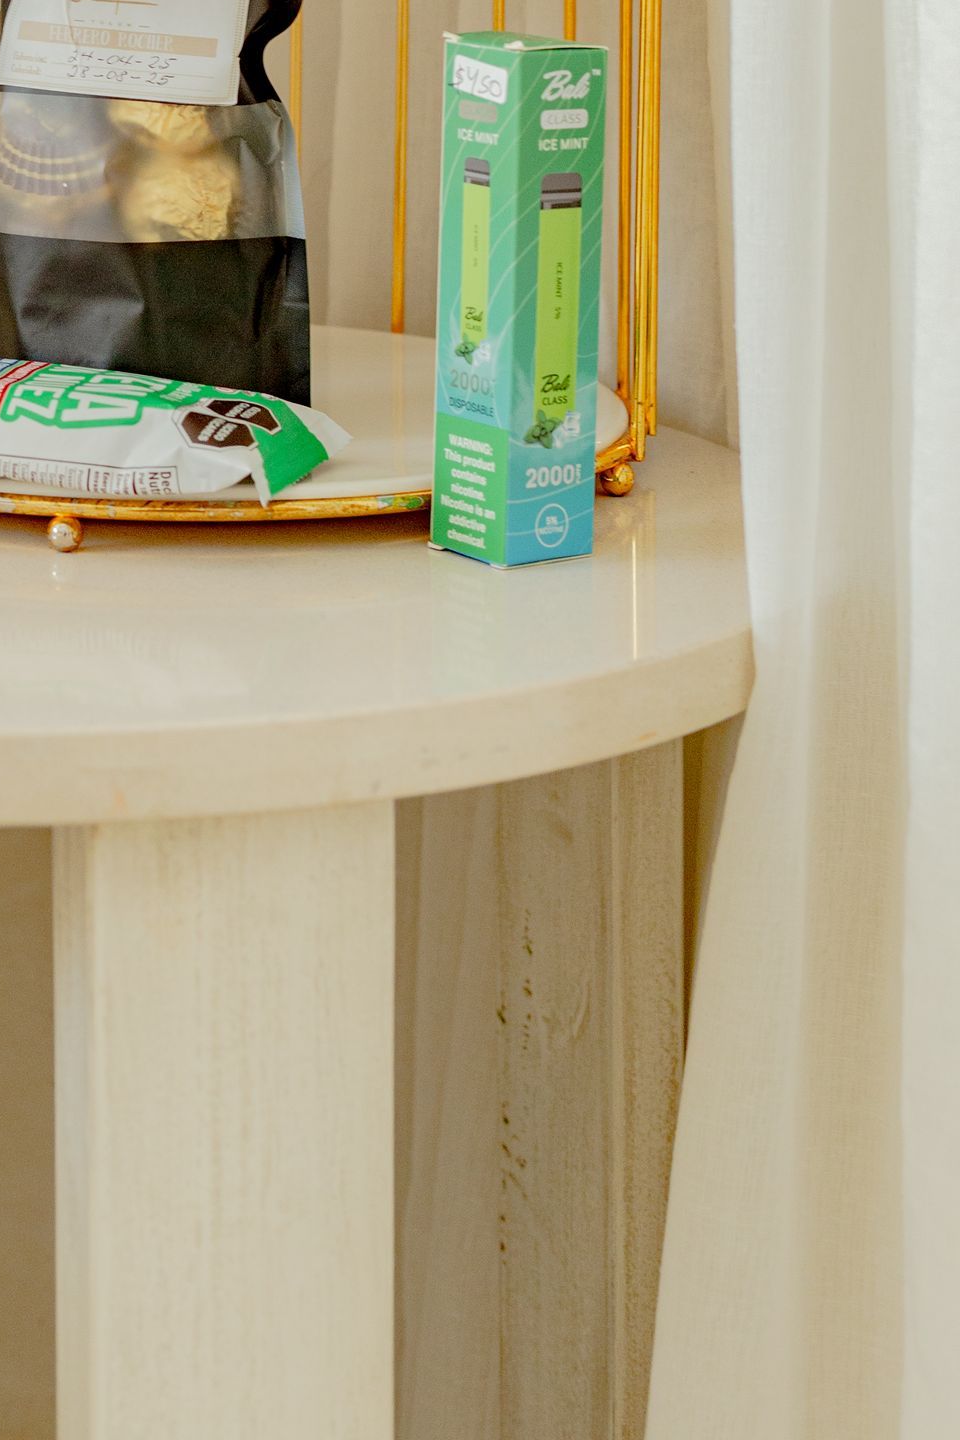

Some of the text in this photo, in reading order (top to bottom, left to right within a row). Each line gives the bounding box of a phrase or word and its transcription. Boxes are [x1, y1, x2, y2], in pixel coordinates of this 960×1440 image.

[49, 24, 110, 47] FERRERO
[541, 70, 591, 101] Bali
[546, 115, 582, 125] CLASS
[458, 128, 499, 145] ICE MINT
[539, 137, 589, 151] ICE MINT
[450, 369, 490, 396] 2000
[449, 396, 494, 417] DISPOSABLE
[542, 395, 568, 406] CLASS
[449, 433, 493, 456] WARNING:
[444, 448, 496, 473] This product
[525, 464, 575, 489] 2000
[441, 494, 474, 513] Nicotine
